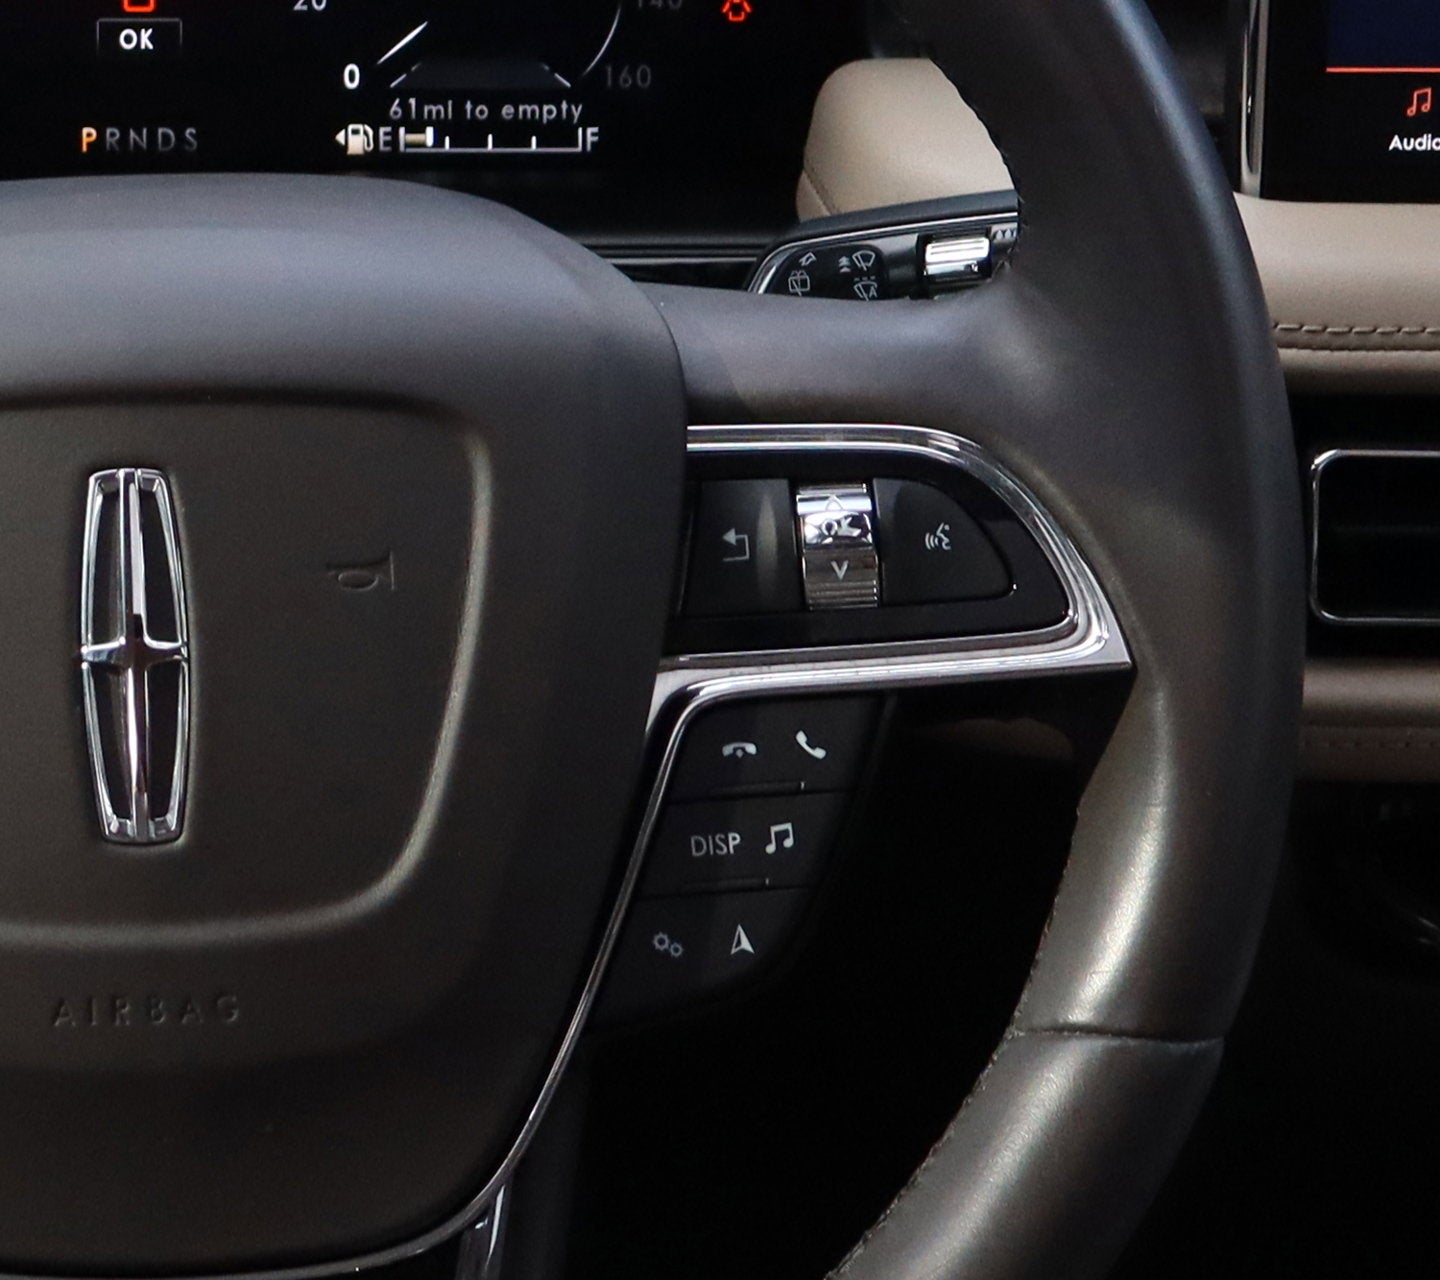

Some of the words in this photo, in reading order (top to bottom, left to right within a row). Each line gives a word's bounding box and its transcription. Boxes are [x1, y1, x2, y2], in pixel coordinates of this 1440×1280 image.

[118, 27, 155, 50] OK
[342, 63, 361, 90] 0
[604, 64, 653, 89] 160
[464, 99, 490, 121] to
[500, 101, 584, 124] empty
[378, 127, 393, 152] E
[586, 127, 600, 151] F
[690, 831, 742, 857] DISP
[52, 994, 242, 1028] AIRBAG
